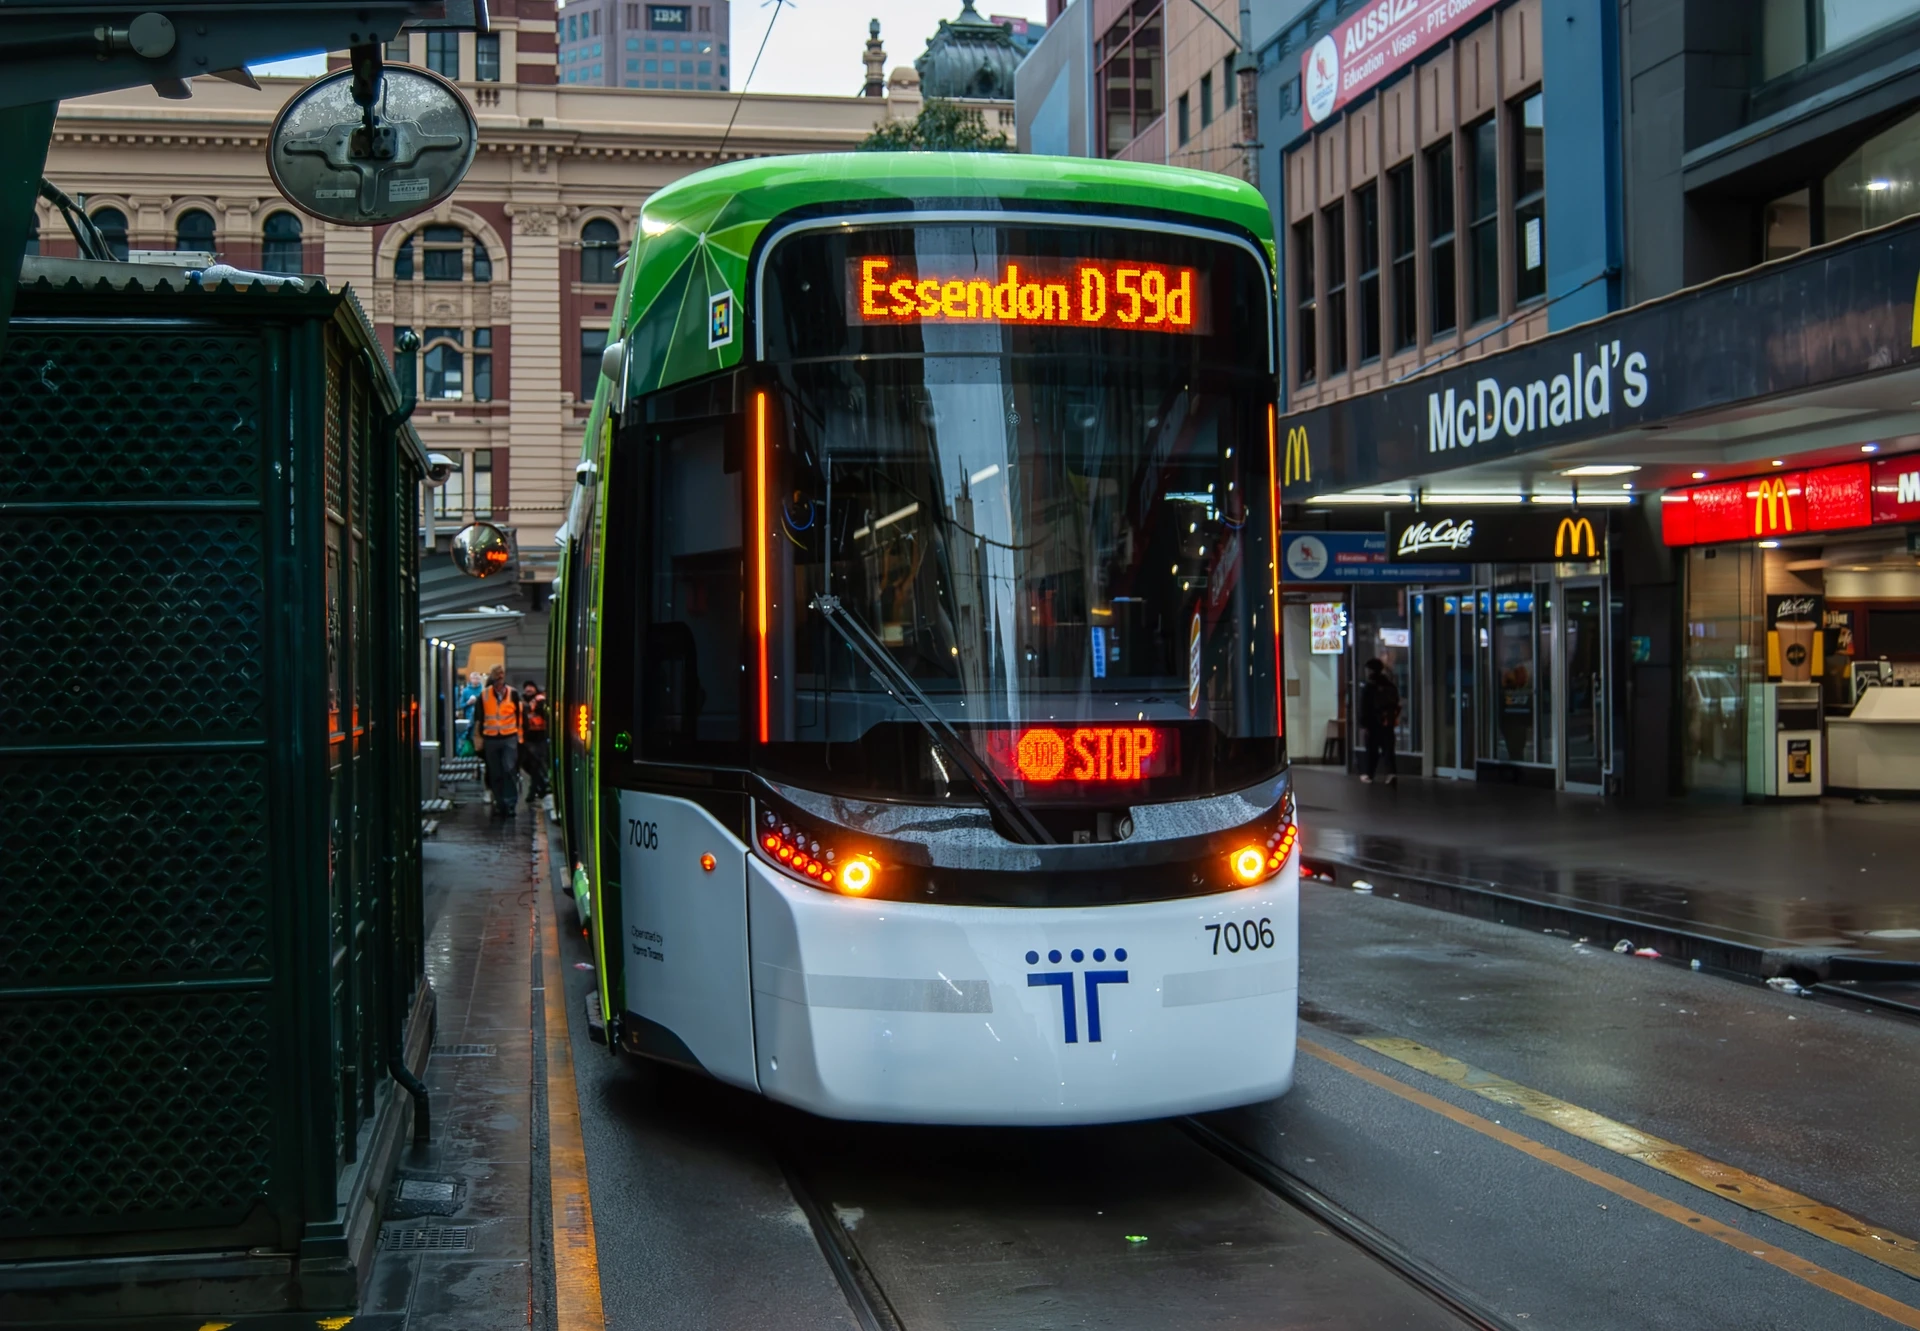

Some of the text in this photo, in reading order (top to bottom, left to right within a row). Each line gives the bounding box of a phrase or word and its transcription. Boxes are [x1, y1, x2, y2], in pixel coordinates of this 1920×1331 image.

[654, 9, 682, 22] IBM
[1343, 0, 1477, 91] Education Visas PTE Coa
[862, 260, 1192, 325] Essendon D 59d
[1429, 340, 1648, 452] McDonald's
[1397, 518, 1474, 556] McCafé
[1073, 728, 1153, 780] STOP
[628, 818, 659, 850] 7006
[631, 925, 656, 942] Operated
[1205, 917, 1274, 955] 7006
